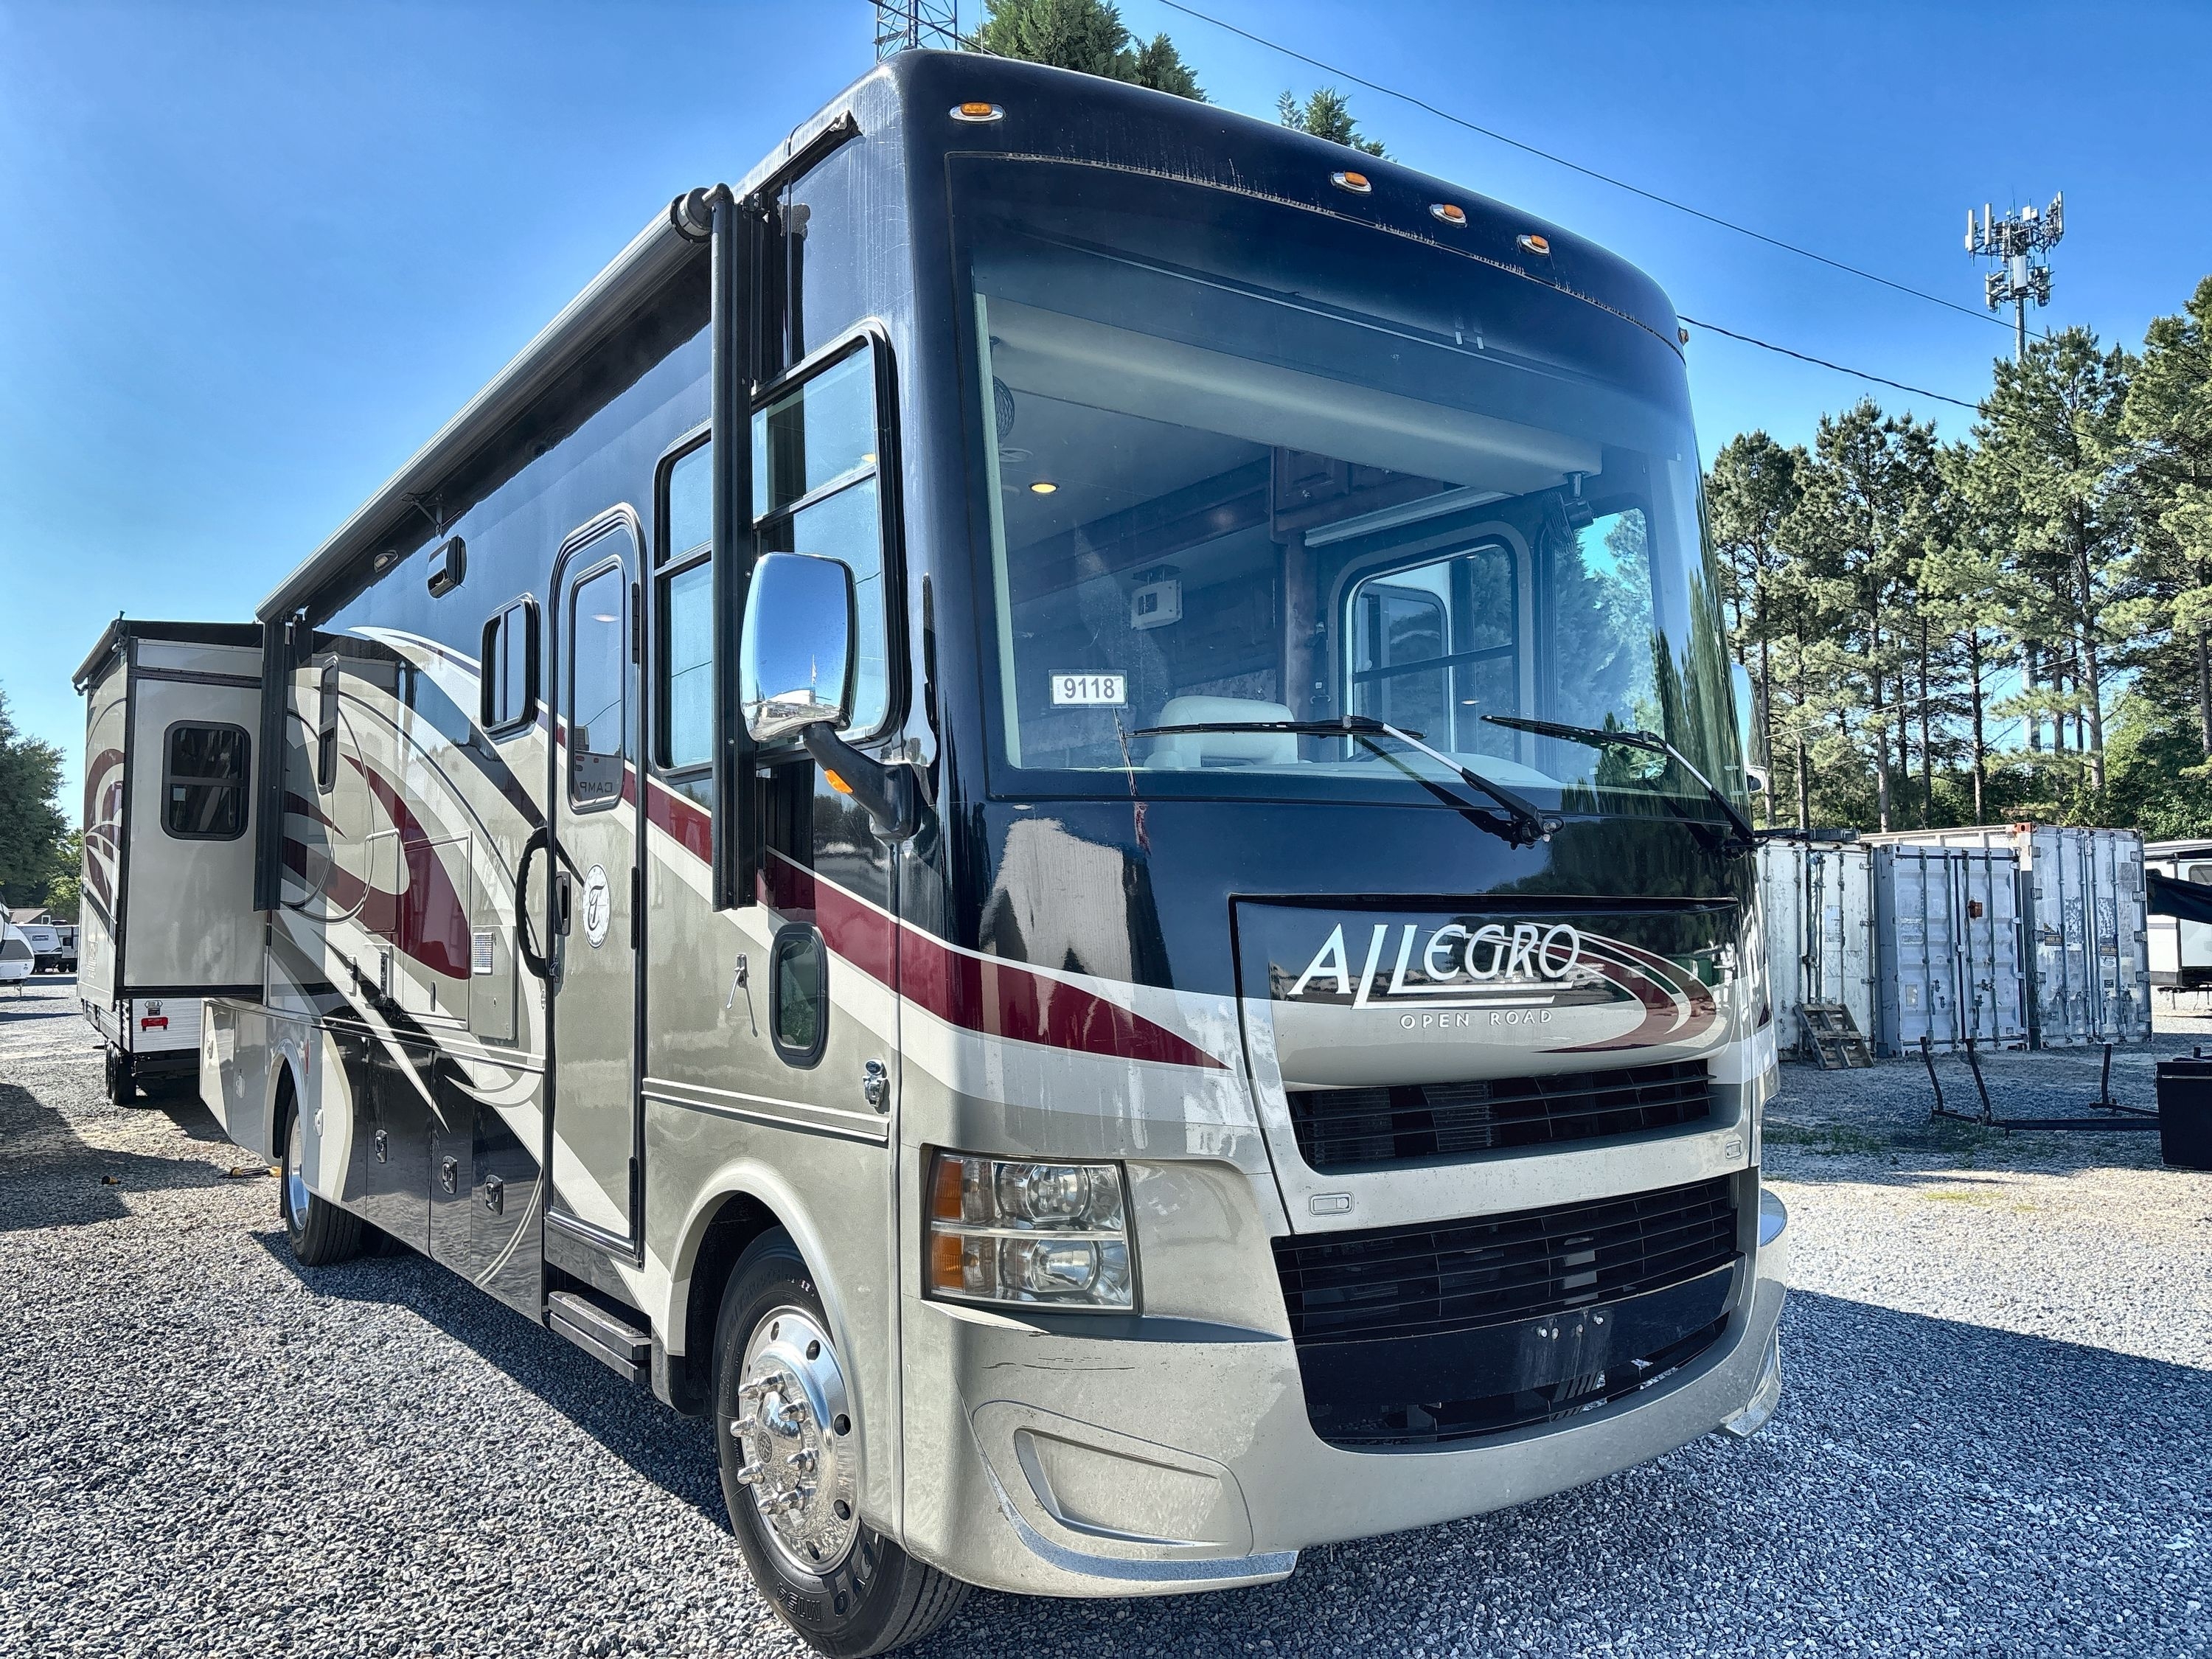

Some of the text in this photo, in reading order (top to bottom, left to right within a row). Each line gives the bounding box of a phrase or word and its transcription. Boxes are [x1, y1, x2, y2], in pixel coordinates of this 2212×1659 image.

[1064, 678, 1115, 699] 9118
[1287, 922, 1580, 1009] ALLEGRO
[1400, 1009, 1552, 1029] OPEN ROAD
[776, 1582, 821, 1621] M154
